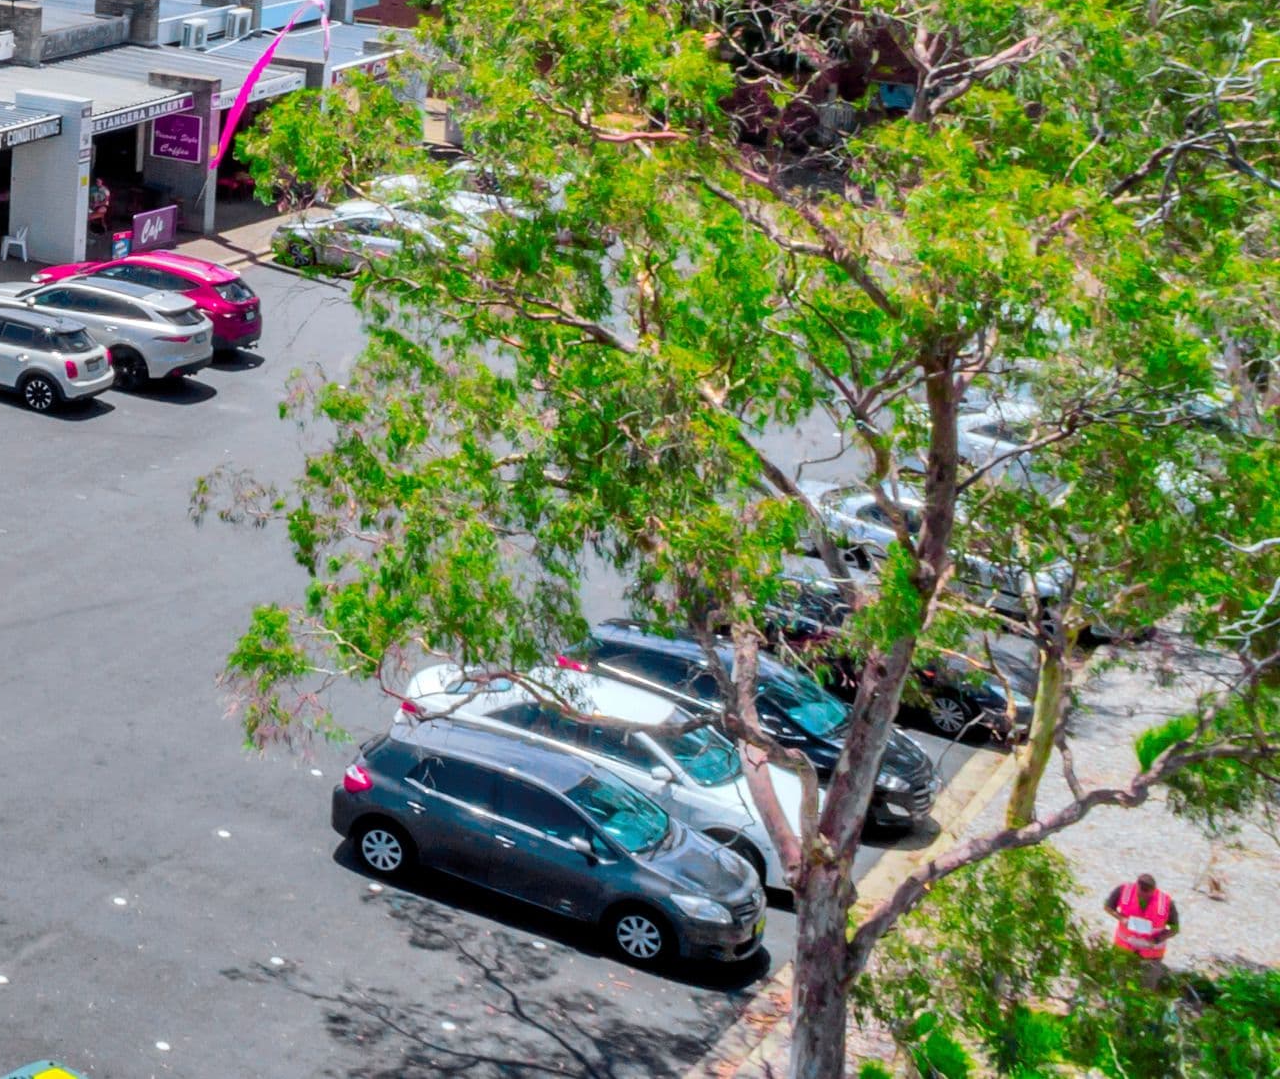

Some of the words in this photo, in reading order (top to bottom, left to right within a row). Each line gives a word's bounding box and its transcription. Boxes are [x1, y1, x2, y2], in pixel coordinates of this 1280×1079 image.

[149, 98, 185, 118] BAKERY
[159, 143, 190, 157] Coffee
[141, 216, 164, 244] Cafe
